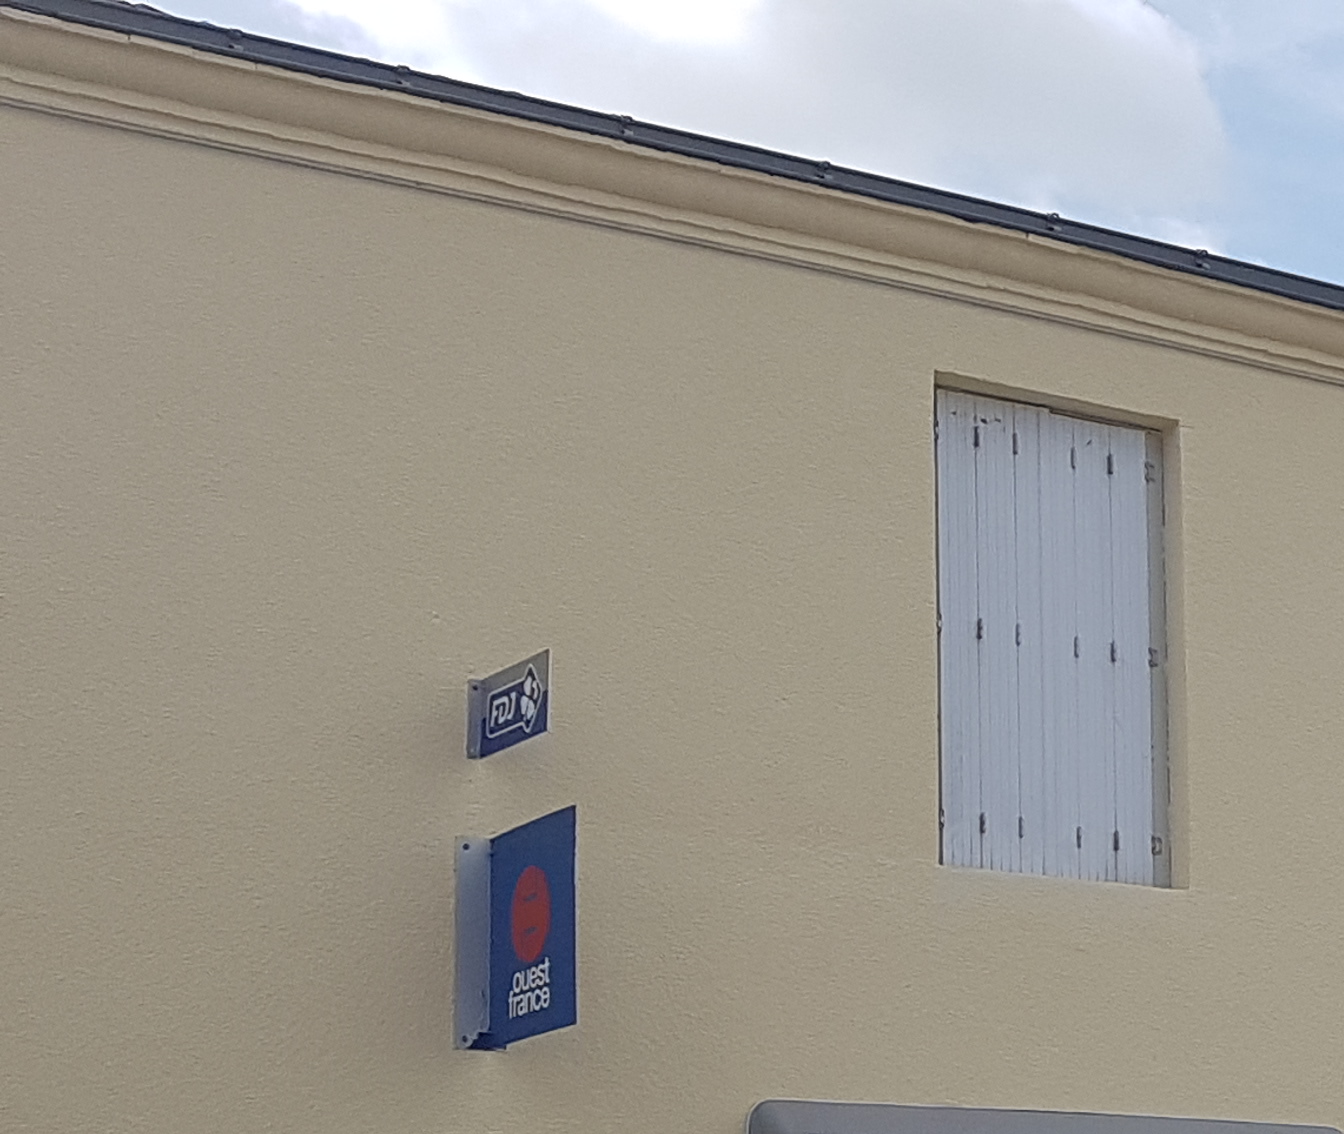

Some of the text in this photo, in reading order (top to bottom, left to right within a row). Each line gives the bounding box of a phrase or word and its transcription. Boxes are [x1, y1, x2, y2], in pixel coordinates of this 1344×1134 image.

[490, 692, 516, 727] FDJ
[512, 956, 550, 993] ouest
[508, 986, 550, 1020] france
